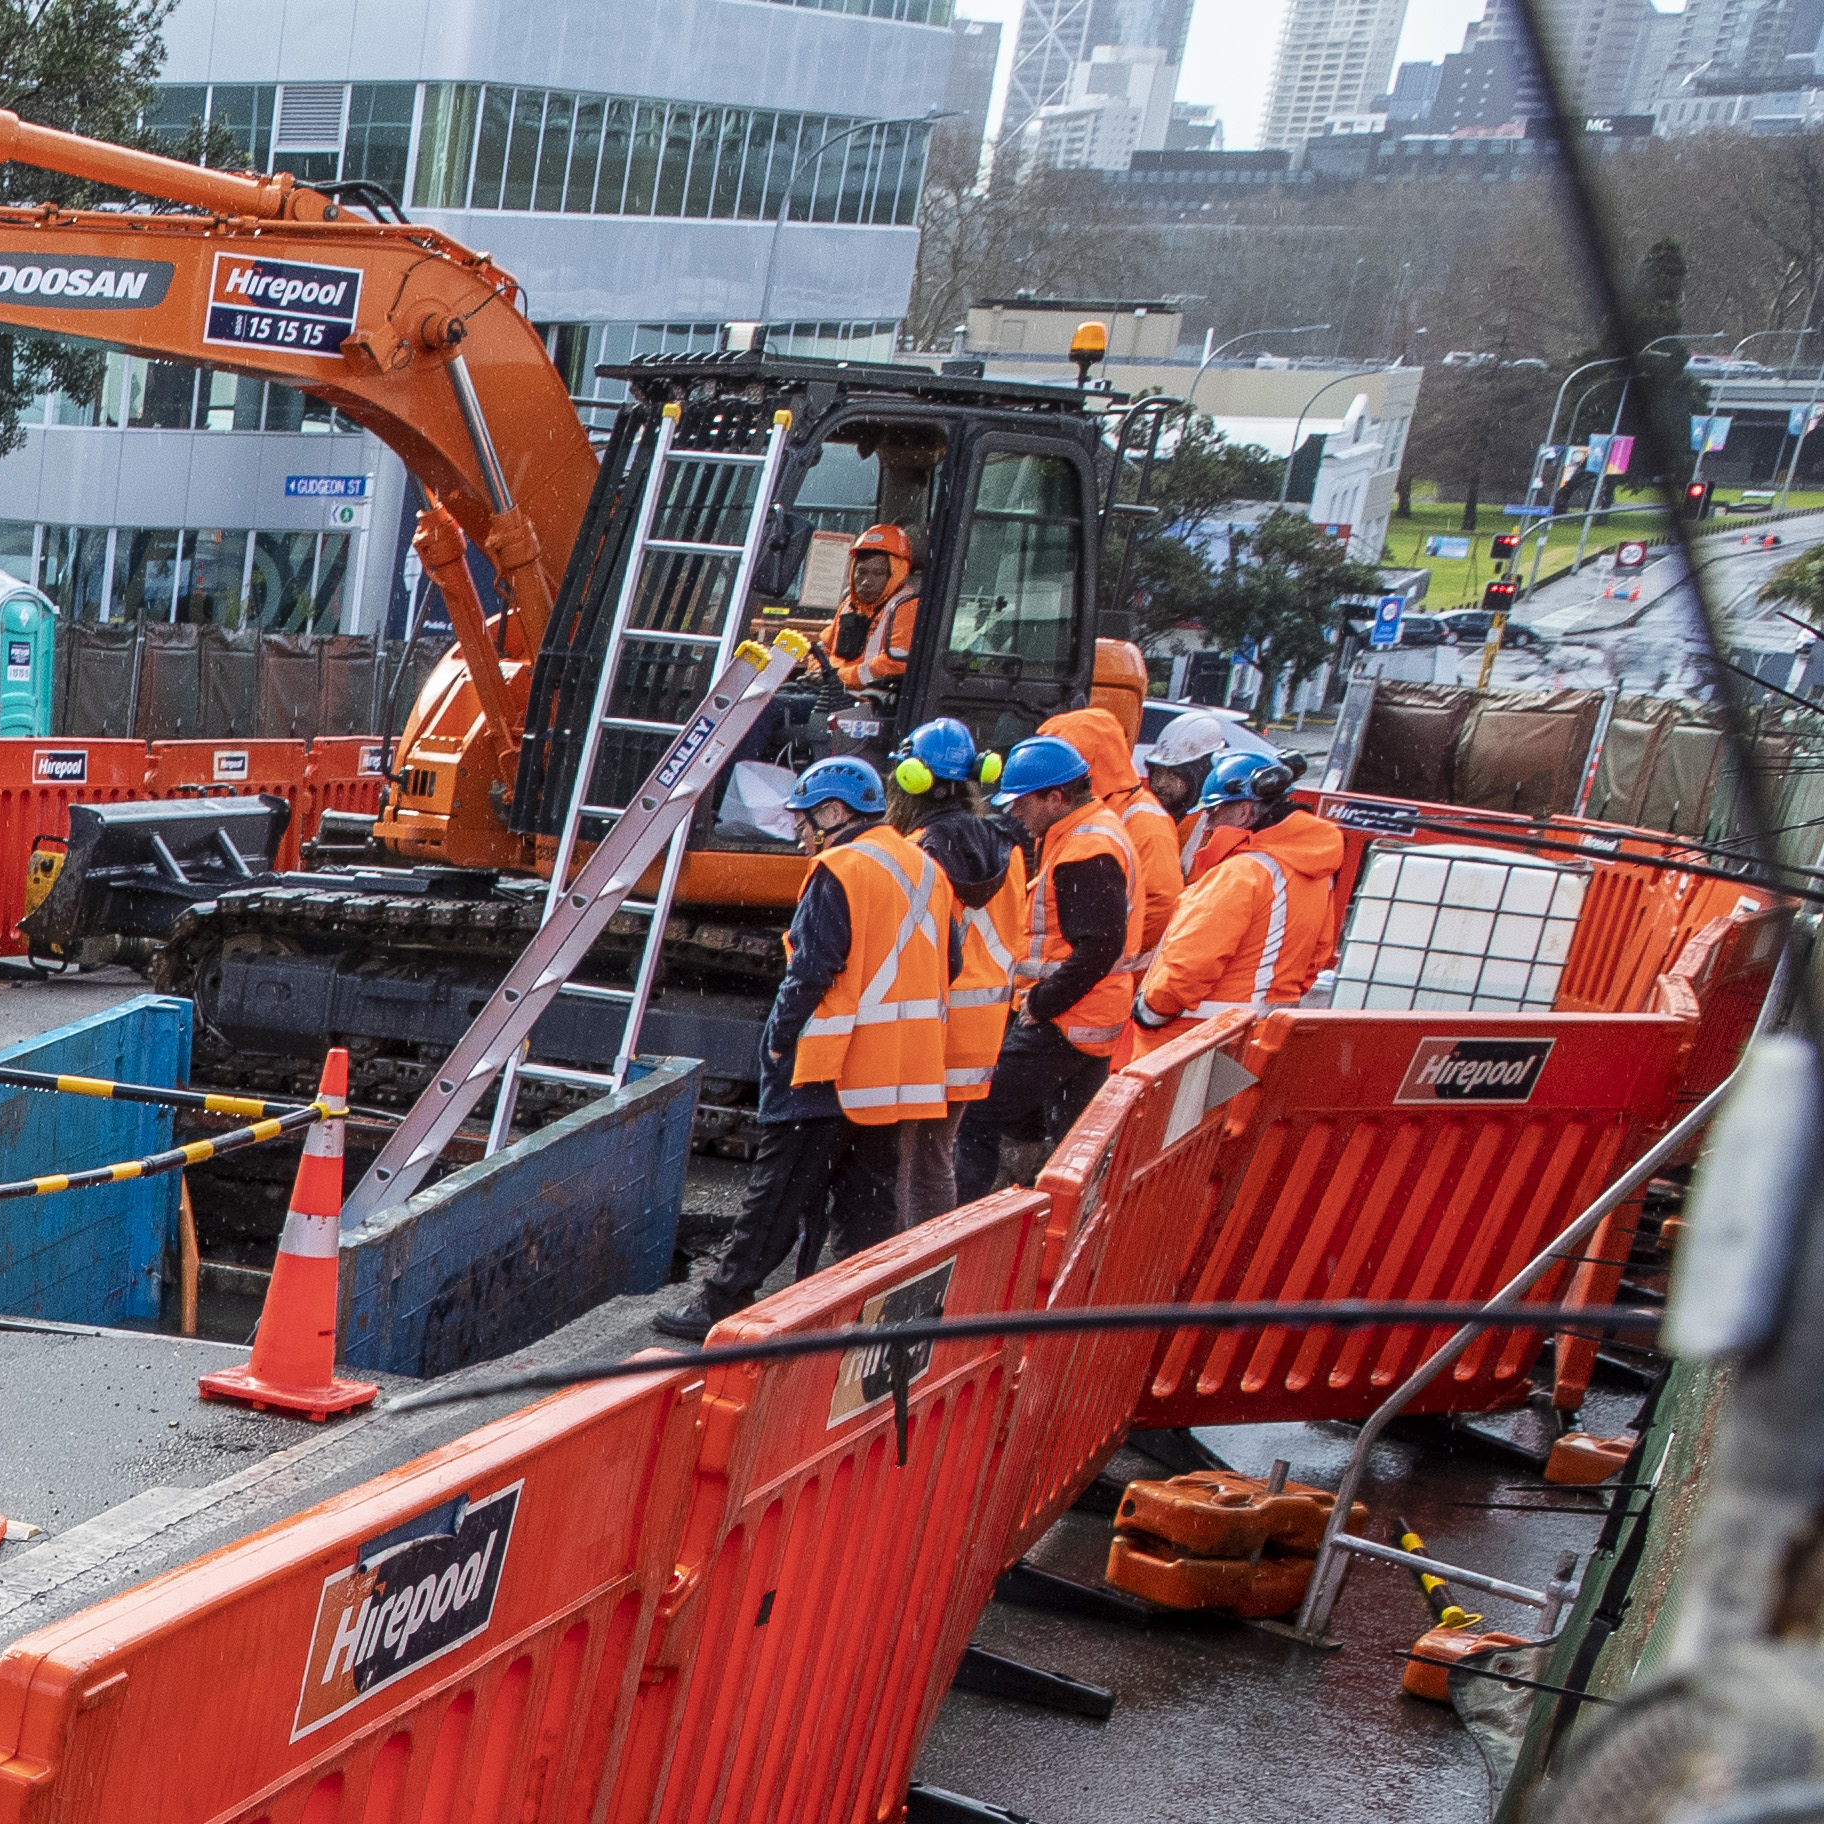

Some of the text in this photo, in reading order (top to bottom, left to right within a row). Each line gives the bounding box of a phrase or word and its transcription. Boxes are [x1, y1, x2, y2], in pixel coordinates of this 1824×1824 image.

[225, 267, 347, 307] Hirepool
[249, 317, 270, 339] 15
[276, 319, 298, 341] 15
[302, 321, 326, 346] 15
[297, 480, 362, 493] GUDGEON ST
[38, 755, 82, 778] Hirepool
[658, 718, 711, 786] BAILEY
[1414, 1053, 1535, 1093] Hirepool
[321, 1529, 499, 1686] Hirepool
